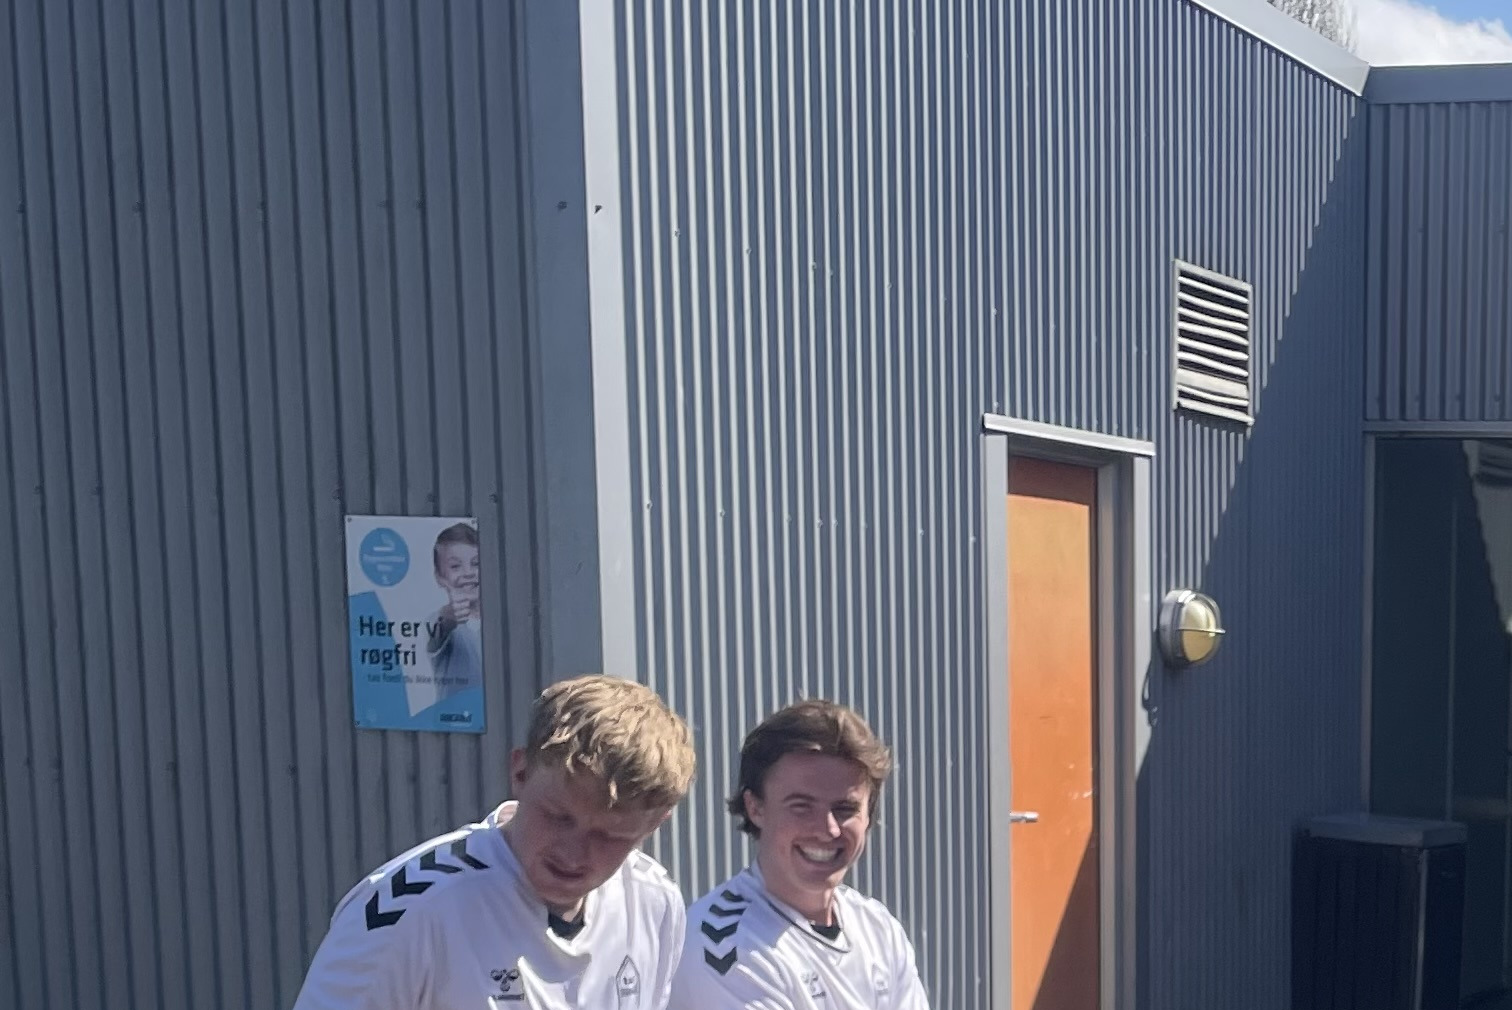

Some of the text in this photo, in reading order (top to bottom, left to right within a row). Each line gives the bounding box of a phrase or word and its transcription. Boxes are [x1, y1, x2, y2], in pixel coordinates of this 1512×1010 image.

[359, 615, 443, 638] Her er vi
[361, 643, 417, 671] røgfri
